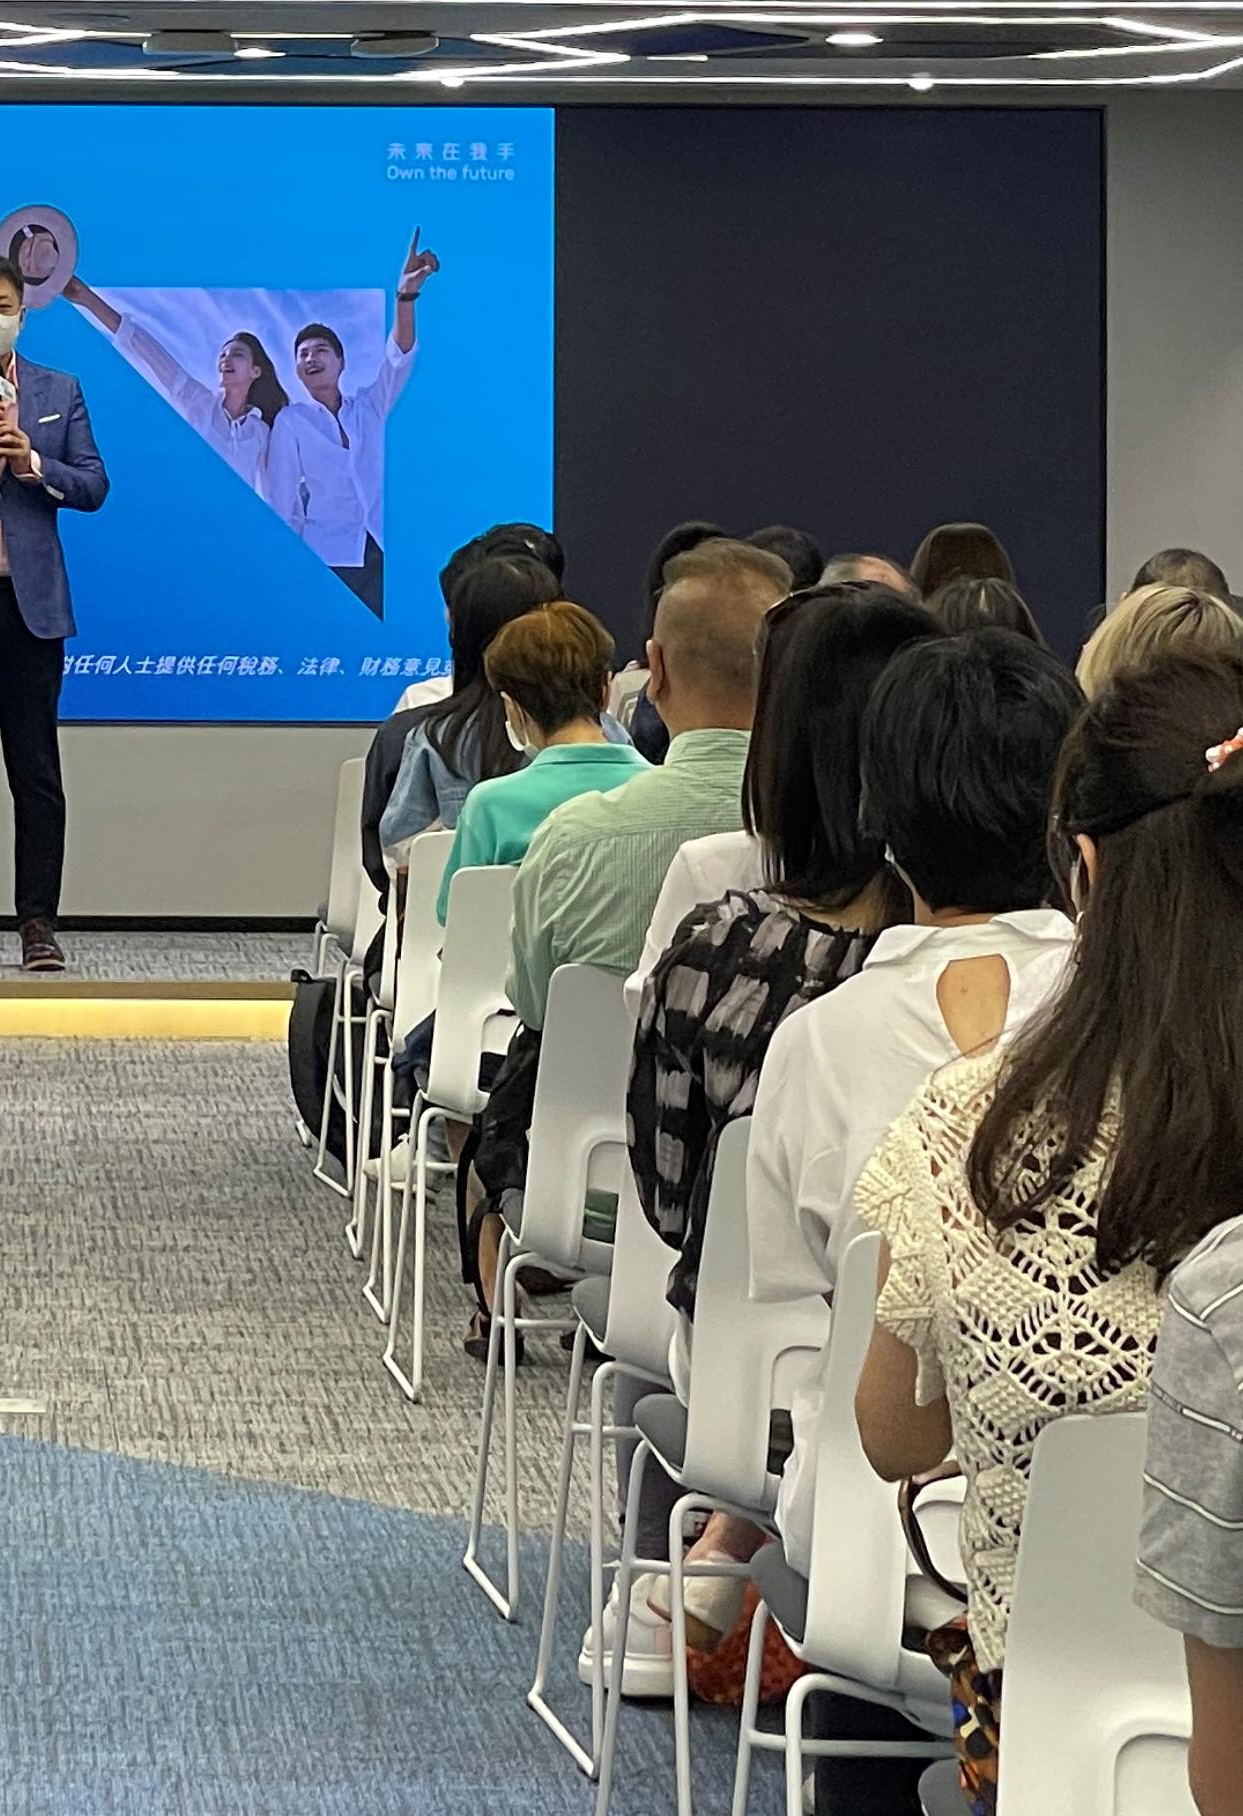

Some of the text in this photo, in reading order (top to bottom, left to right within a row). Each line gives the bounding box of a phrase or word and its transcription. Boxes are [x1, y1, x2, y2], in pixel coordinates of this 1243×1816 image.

[387, 165, 515, 181] Own the future
